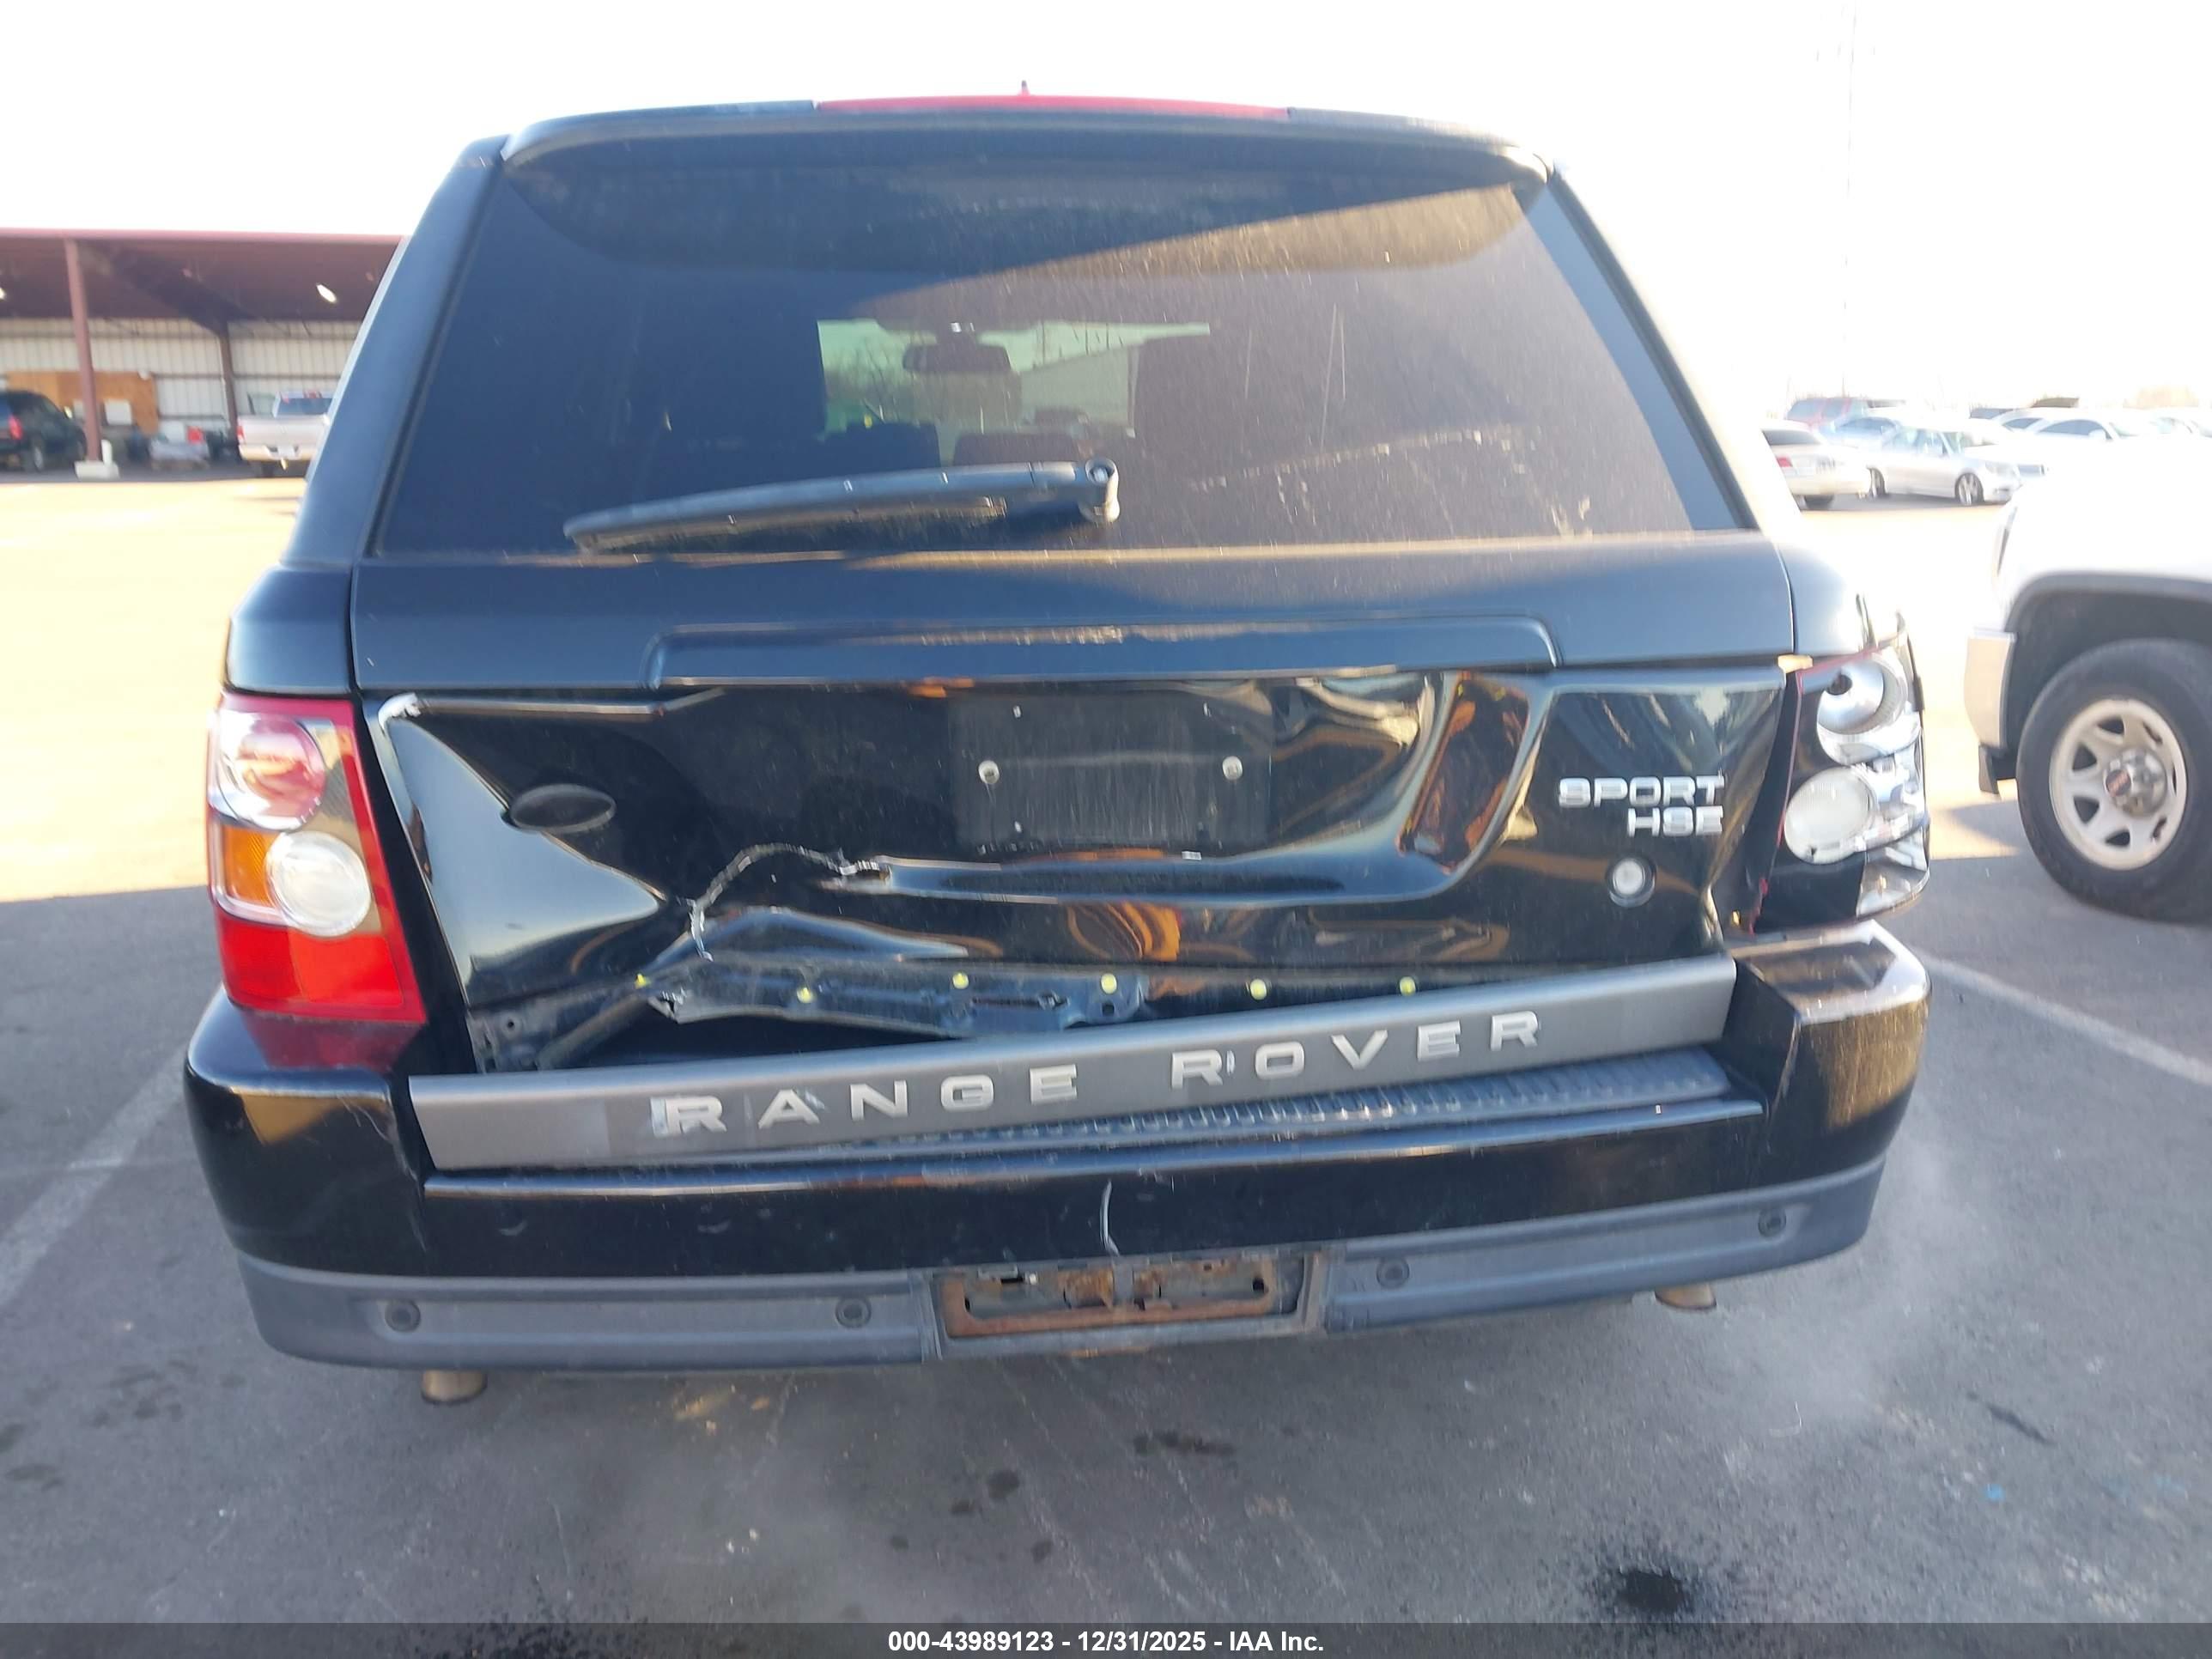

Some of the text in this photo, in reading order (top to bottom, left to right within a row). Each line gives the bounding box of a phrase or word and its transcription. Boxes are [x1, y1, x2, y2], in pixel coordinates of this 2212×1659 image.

[1559, 775, 1725, 809] SPORT
[1627, 805, 1724, 838] HSE
[651, 1010, 1540, 1135] RANGE ROVER
